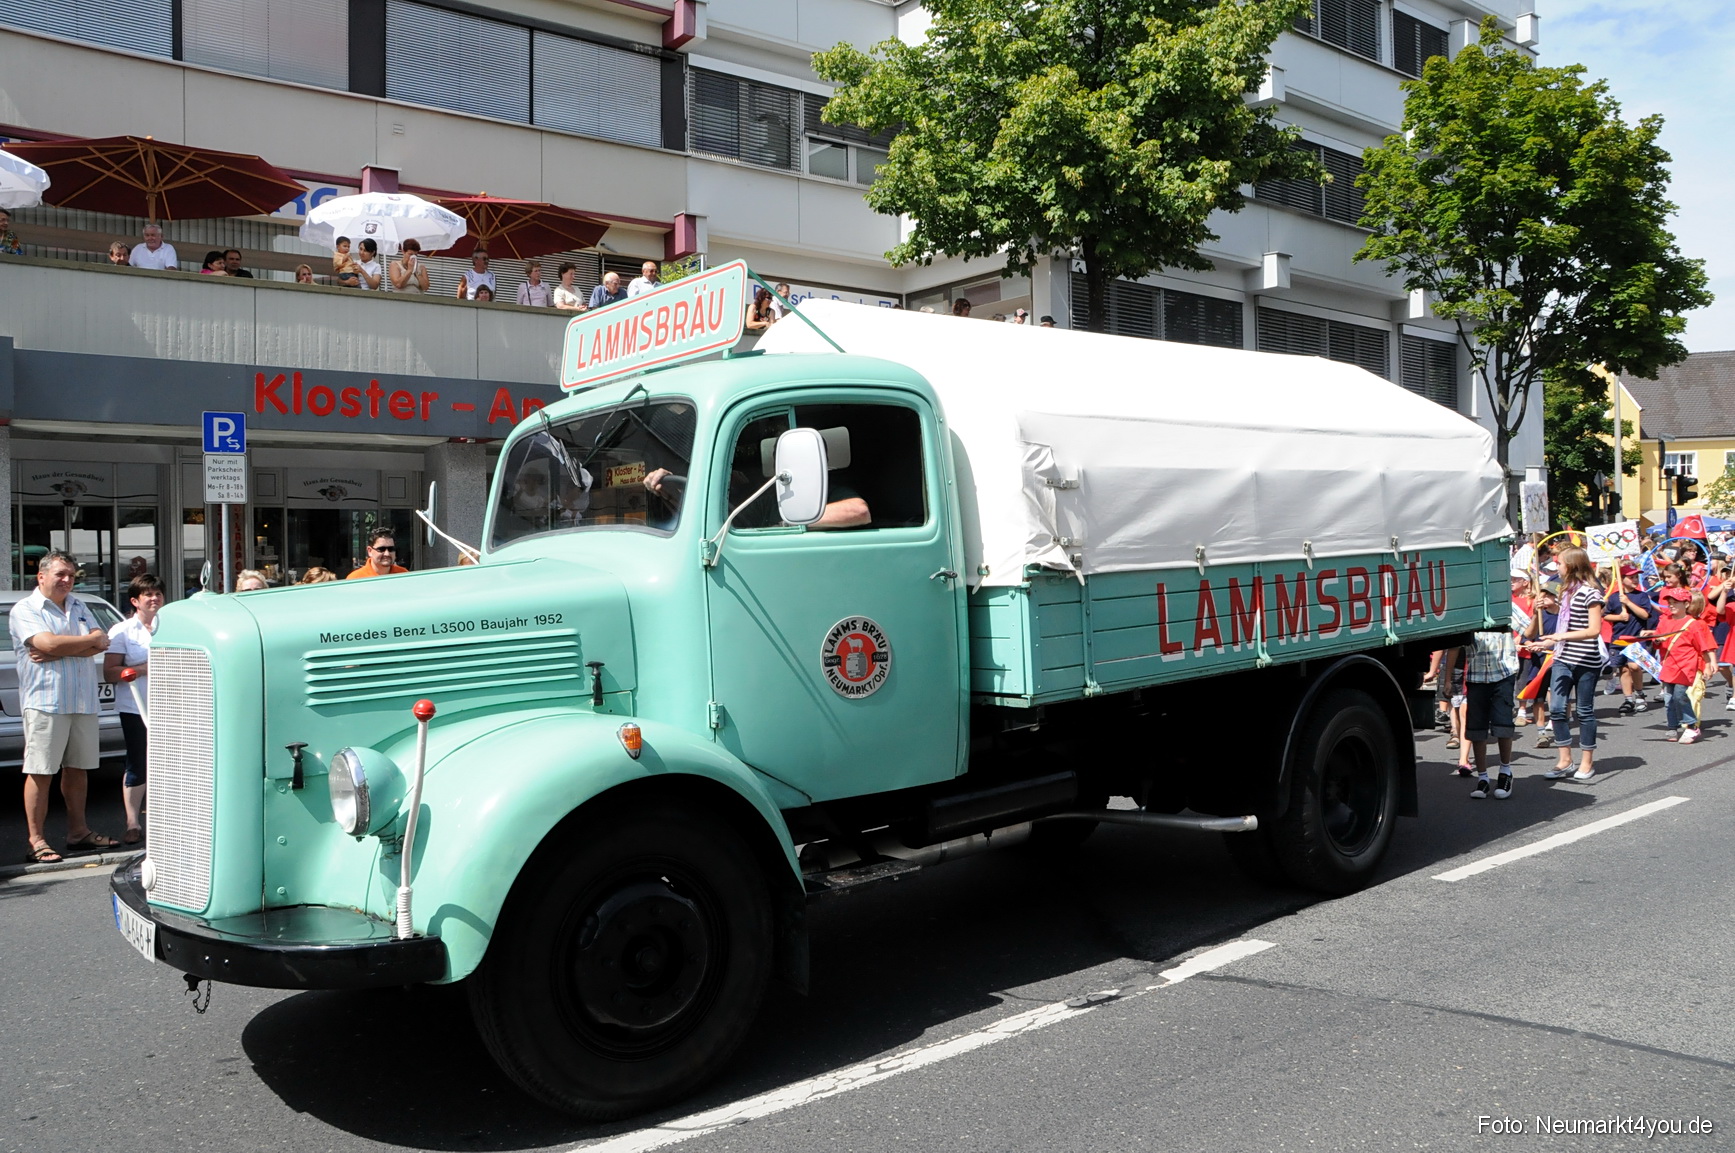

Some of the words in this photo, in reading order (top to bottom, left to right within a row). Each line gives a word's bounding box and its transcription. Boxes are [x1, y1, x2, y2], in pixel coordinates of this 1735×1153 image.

[576, 283, 727, 372] LAMMSBRÄU
[254, 371, 439, 421] Kloster
[212, 417, 236, 448] P
[31, 473, 50, 481] Haus
[65, 471, 105, 482] Gesundheit
[210, 474, 241, 482] werktags
[329, 477, 363, 487] Gesundheit
[1156, 551, 1449, 662] LAMMSBRÄU
[319, 628, 387, 643] Mercedes
[393, 626, 426, 638] Benz
[431, 620, 475, 634] L3500
[480, 617, 529, 631] Baujahr
[534, 613, 563, 626] 1952
[824, 620, 858, 654] LAMMS
[862, 621, 887, 649] BRÄU
